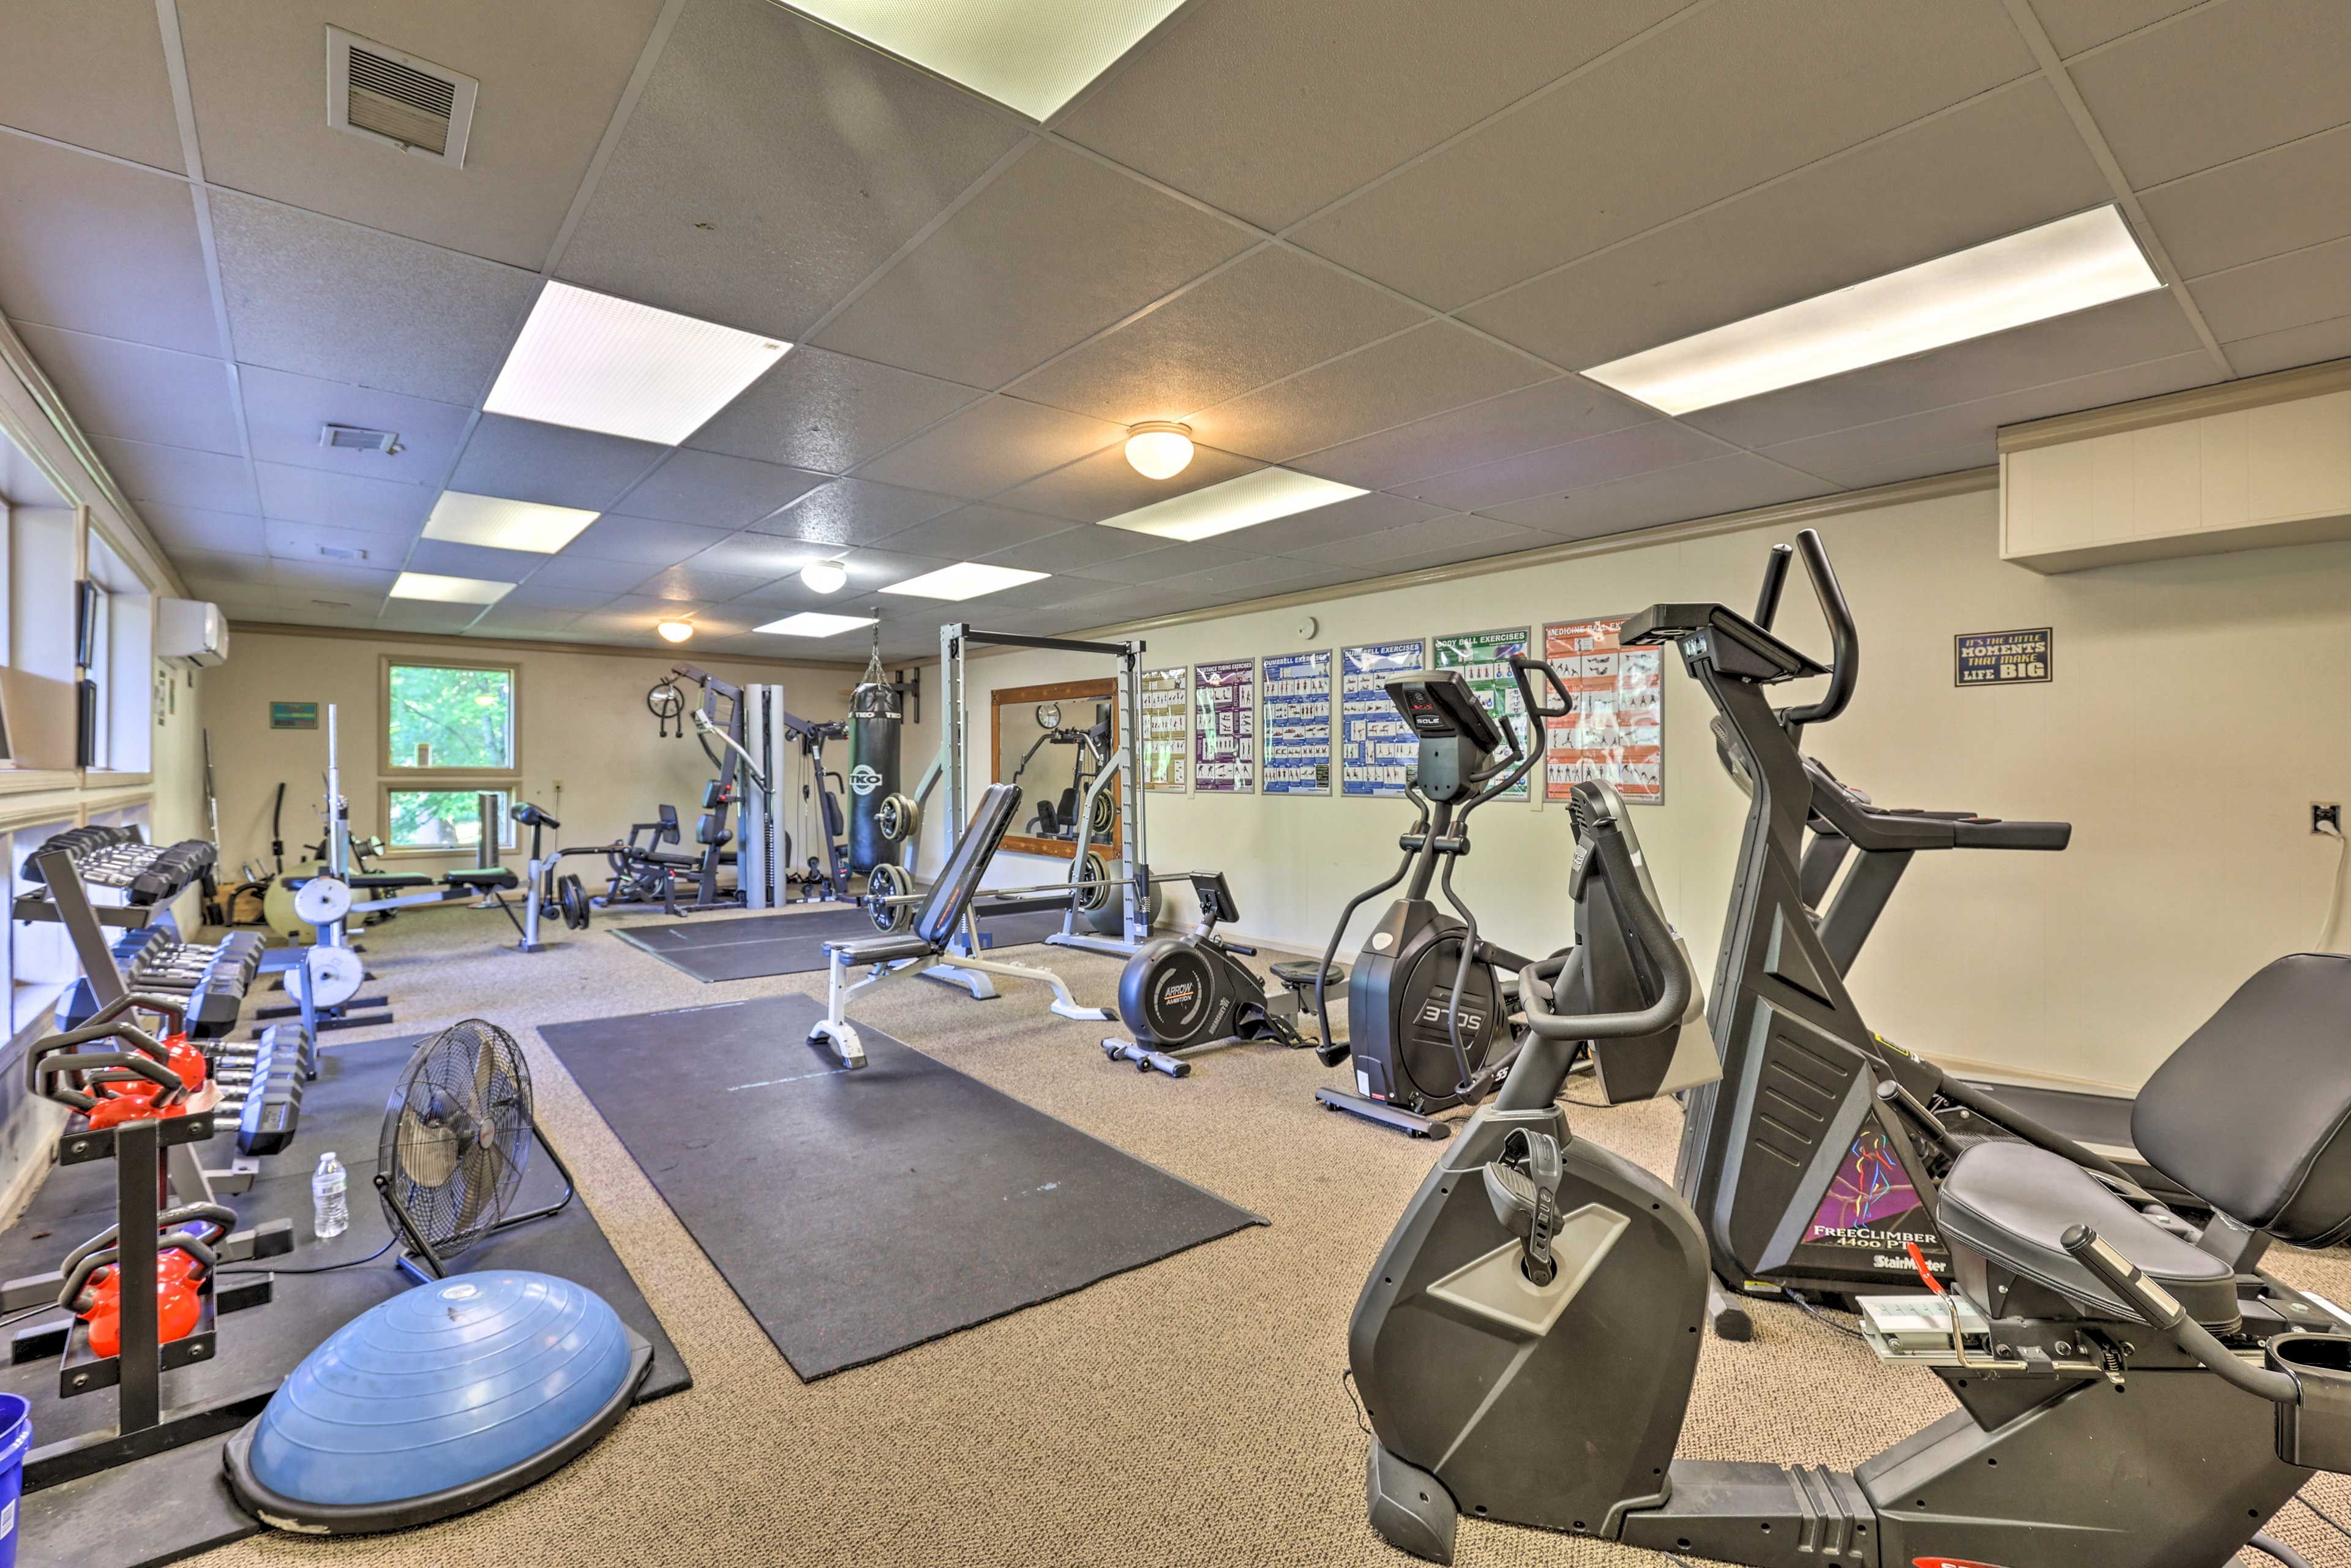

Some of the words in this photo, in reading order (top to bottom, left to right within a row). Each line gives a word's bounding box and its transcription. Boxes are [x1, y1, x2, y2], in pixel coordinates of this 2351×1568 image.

[1548, 626, 1585, 637] MEDICINE
[1480, 632, 1524, 643] EXERCISES
[1966, 638, 1983, 647] IT'S
[1986, 636, 2006, 645] THE
[2008, 634, 2042, 644] LITTLE
[1381, 643, 1419, 654] EXERCISES
[1961, 642, 2046, 658] MOMENTS
[1264, 658, 1293, 666] DUMBBELL
[1968, 656, 1997, 667] THAT
[2000, 653, 2038, 664] MAKE
[1963, 669, 1995, 681] LIFE
[2000, 662, 2045, 679] BIG
[850, 775, 880, 784] TKO
[1165, 982, 1193, 997] ARROW
[1166, 994, 1193, 1005] AMBITION
[1837, 1236, 1881, 1248] 4400
